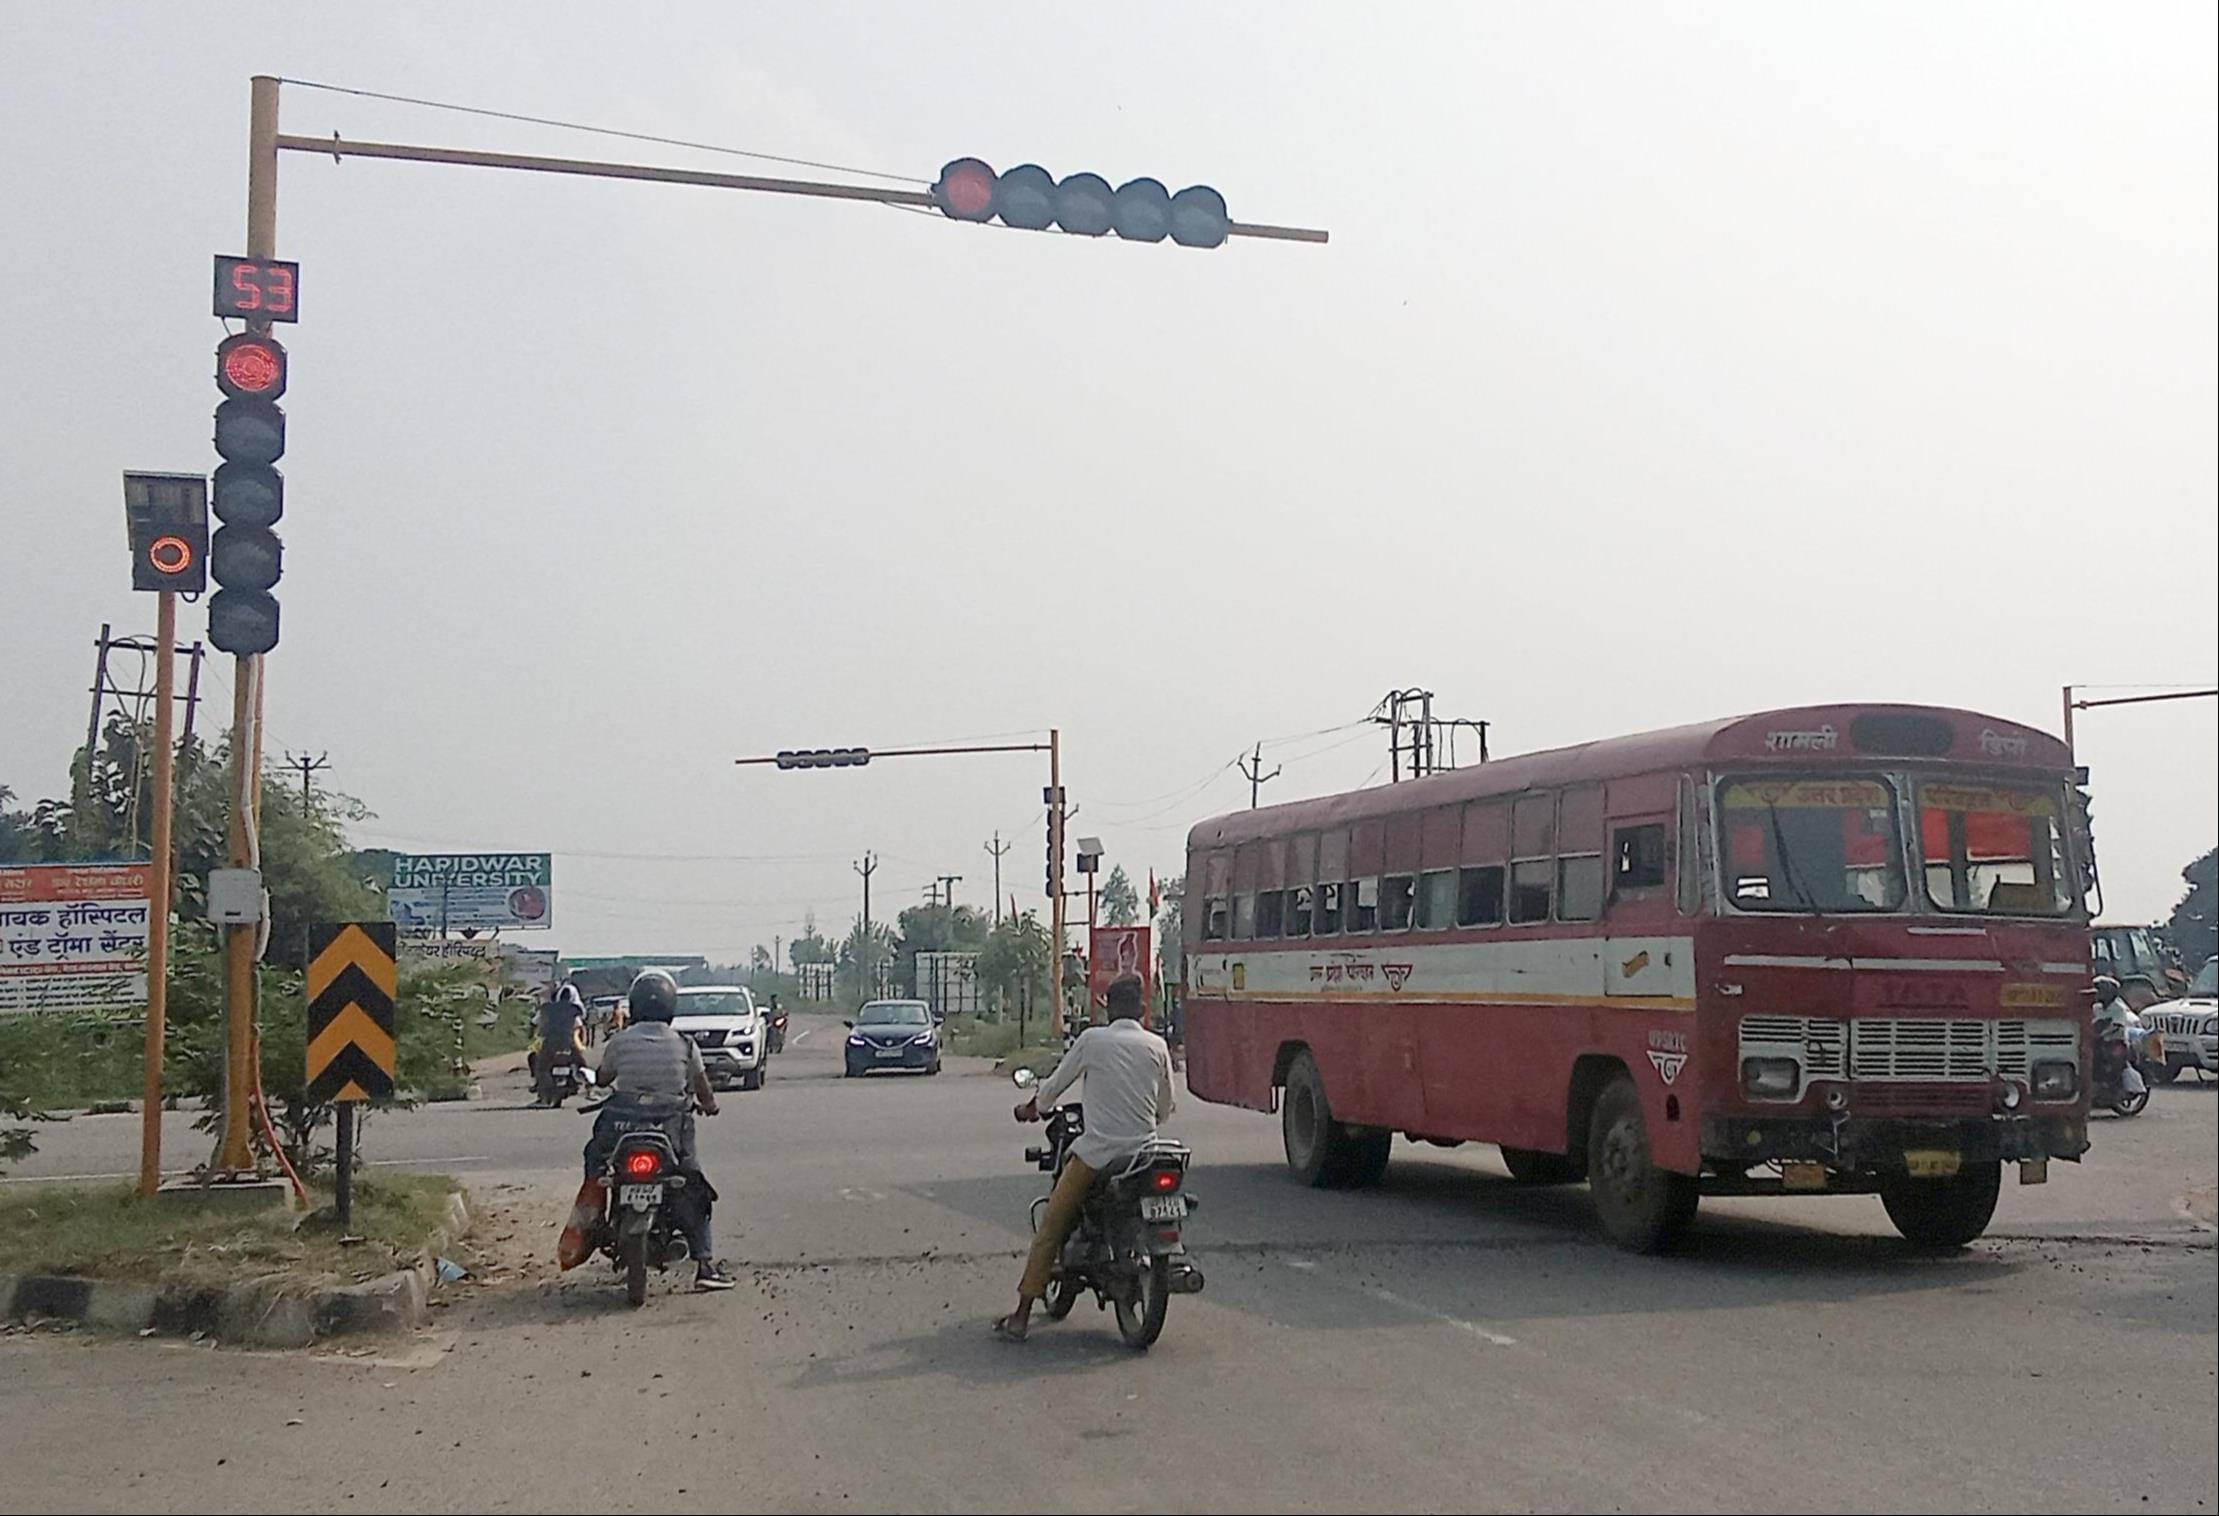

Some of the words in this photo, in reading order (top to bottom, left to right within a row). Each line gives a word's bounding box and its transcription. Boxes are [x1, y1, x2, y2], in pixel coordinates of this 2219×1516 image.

[232, 264, 294, 313] 53
[1764, 724, 1839, 752] शामली
[395, 856, 542, 873] HARIDWAR
[57, 903, 147, 929] हॉस्पिटल
[8, 933, 42, 958] एंड
[46, 932, 93, 960] ट्रॉमा
